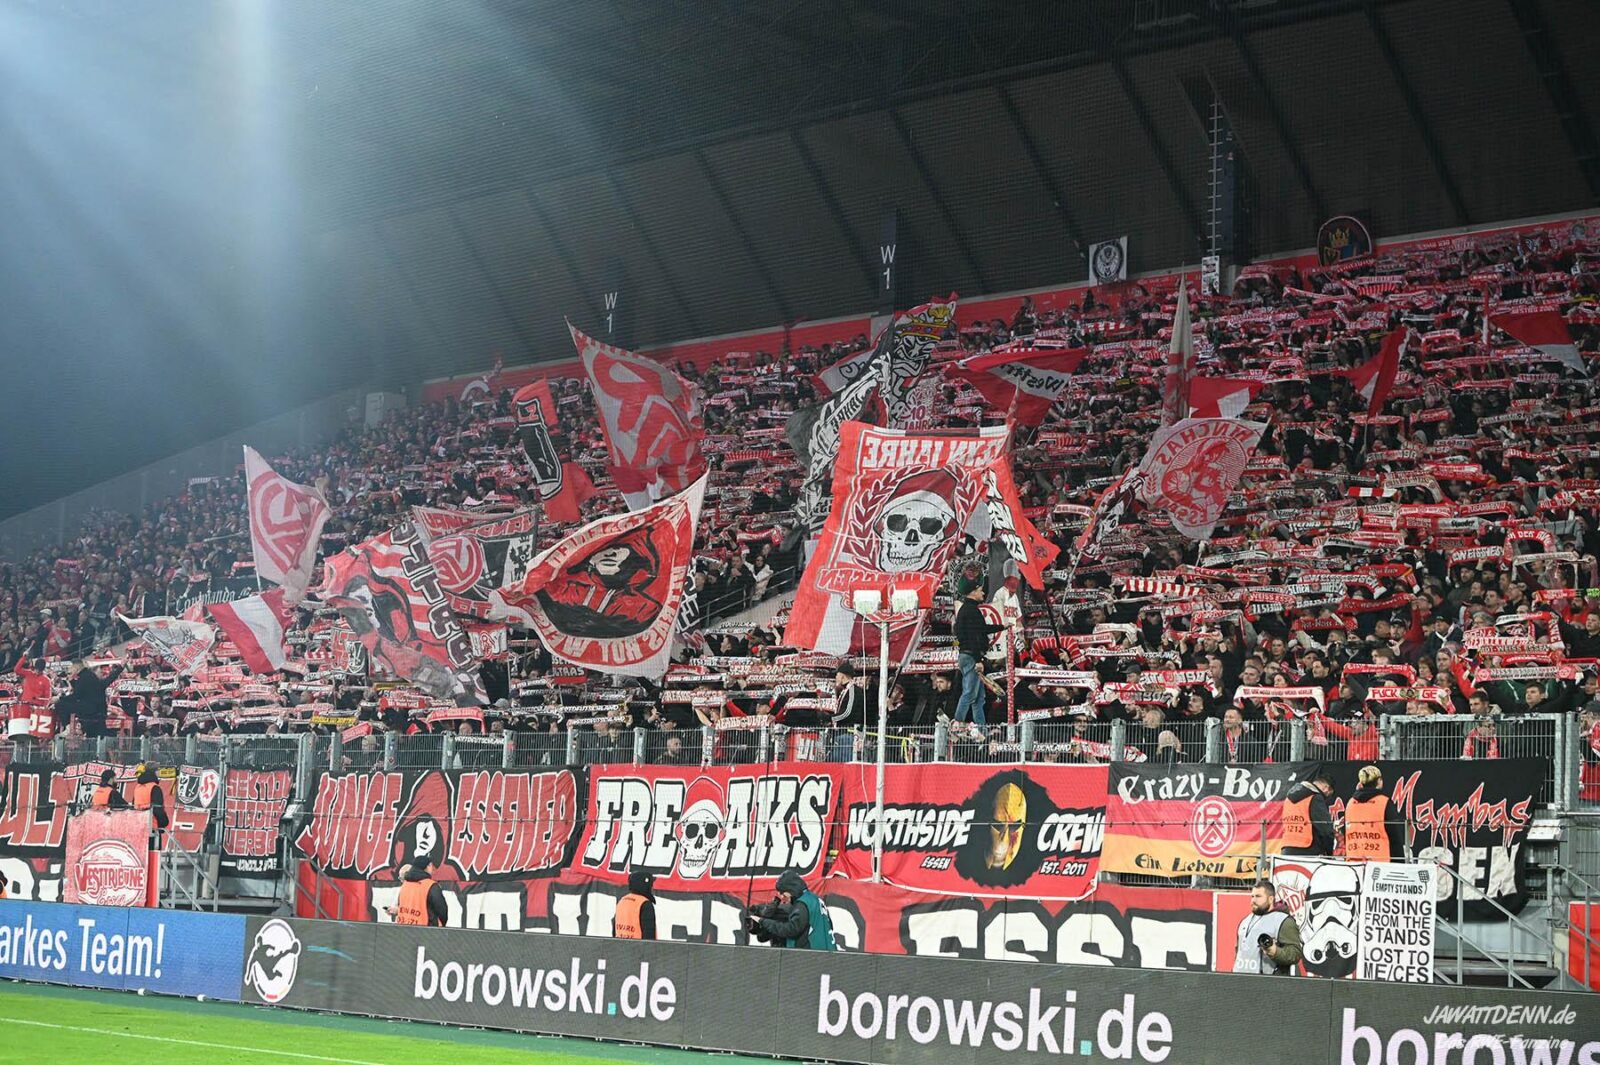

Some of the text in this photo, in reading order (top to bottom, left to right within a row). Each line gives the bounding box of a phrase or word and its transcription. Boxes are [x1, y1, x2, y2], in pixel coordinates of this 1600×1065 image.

[880, 244, 896, 264] W
[883, 268, 890, 289] 1
[604, 292, 618, 310] W
[605, 313, 613, 333] 1
[1371, 689, 1437, 699] FUCK GE
[1391, 770, 1533, 848] Mambas
[296, 769, 577, 875] JUNGE ESSENER
[846, 805, 1106, 854] NORTHSIDE CREW
[920, 856, 952, 871] ESSEN
[1040, 861, 1087, 875] EST. 2011
[1134, 852, 1162, 870] Ein
[1172, 857, 1225, 873] Leben
[1375, 882, 1424, 895] EMPTY STANDS
[1365, 896, 1432, 915] MISSING
[1365, 914, 1431, 929] FROM THE
[1364, 927, 1431, 946] STANDS
[78, 916, 166, 978] Team!
[1364, 946, 1430, 966] LOST TO
[414, 945, 677, 1022] borowski.de
[1363, 964, 1429, 983] ME/CFS
[818, 973, 1173, 1064] borowski.de
